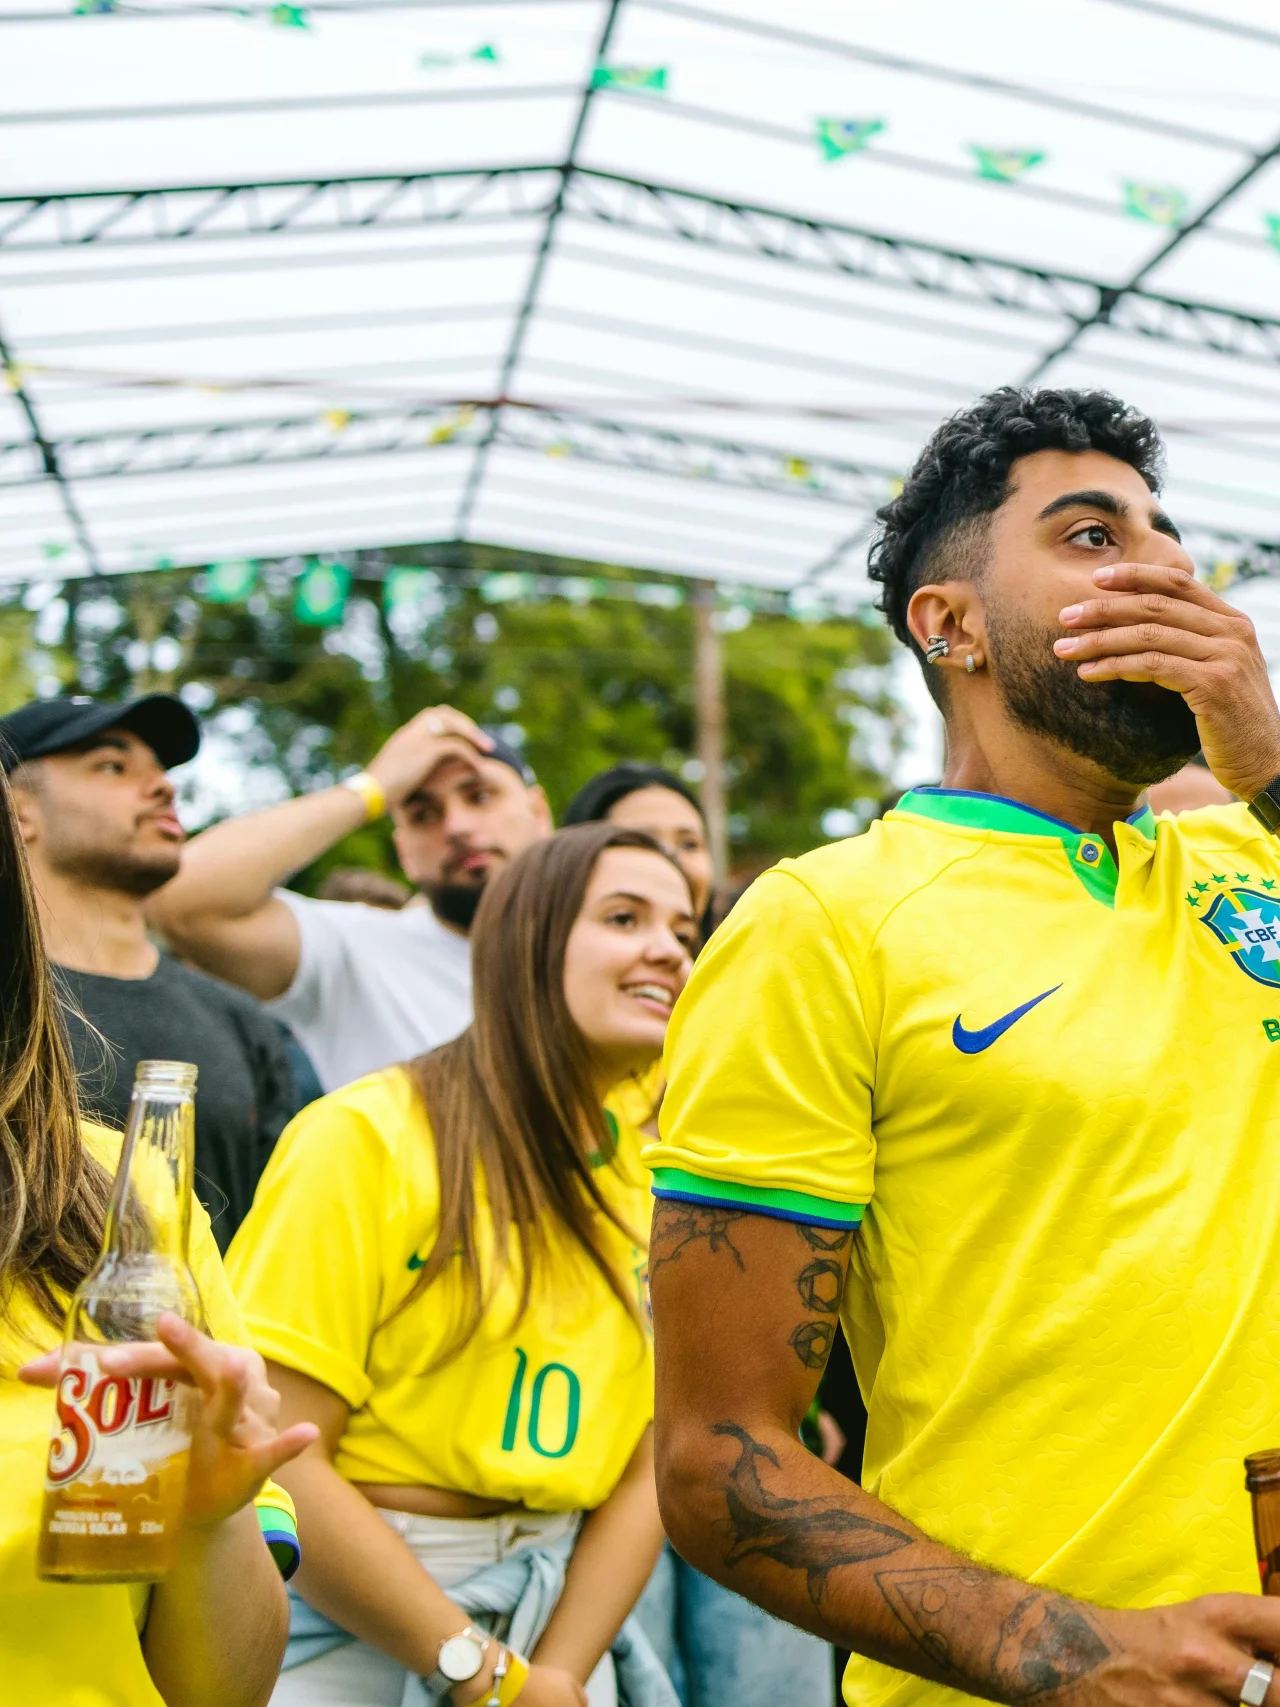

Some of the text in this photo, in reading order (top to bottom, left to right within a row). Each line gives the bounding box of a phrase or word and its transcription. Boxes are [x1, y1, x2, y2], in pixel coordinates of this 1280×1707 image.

[1243, 925, 1278, 944] CBF
[47, 1366, 172, 1483] SOL
[501, 1346, 581, 1459] 10
[89, 1521, 128, 1536] SOLAR
